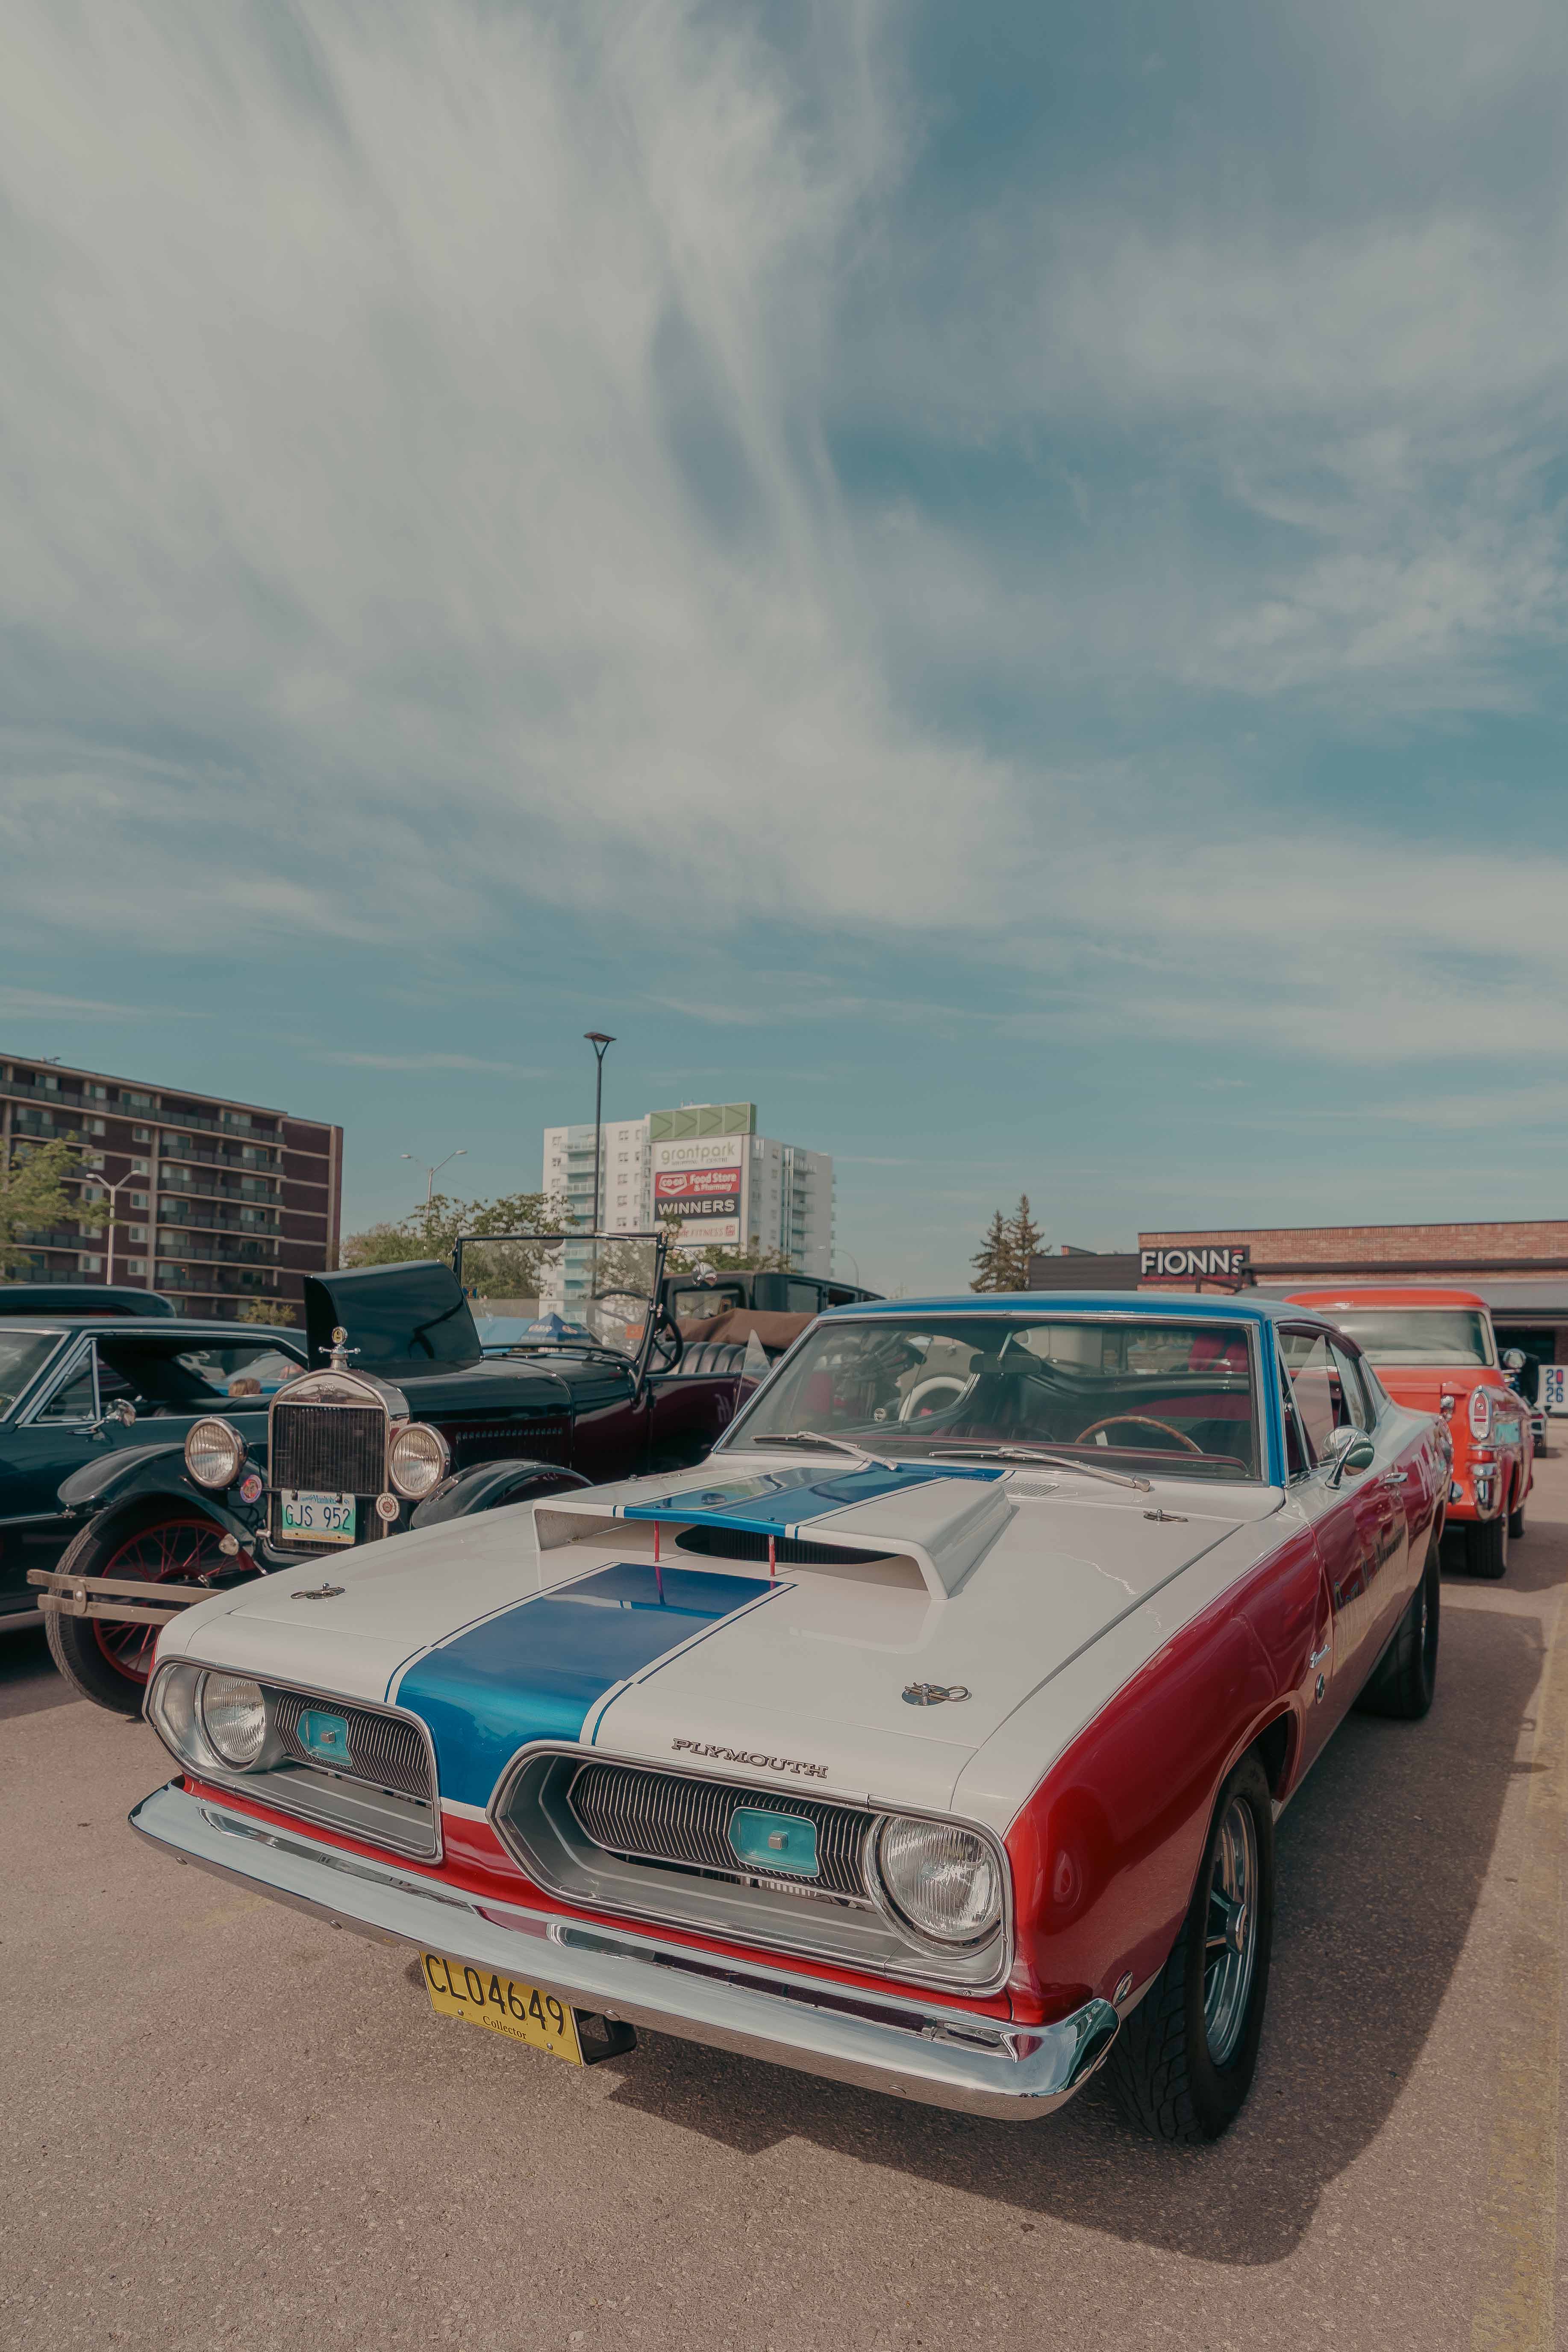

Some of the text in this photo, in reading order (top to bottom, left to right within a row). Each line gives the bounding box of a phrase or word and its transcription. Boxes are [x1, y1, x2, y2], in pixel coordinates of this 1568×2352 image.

[662, 1142, 735, 1165] grantpark
[690, 1172, 737, 1184] Food Store
[701, 1183, 732, 1192] Pharmacy
[658, 1198, 735, 1216] WINNERS
[1546, 1387, 1563, 1402] 26
[286, 1504, 350, 1530] GJS 952
[671, 1738, 829, 1779] PLYMOUTH
[483, 2016, 527, 2040] Collector
